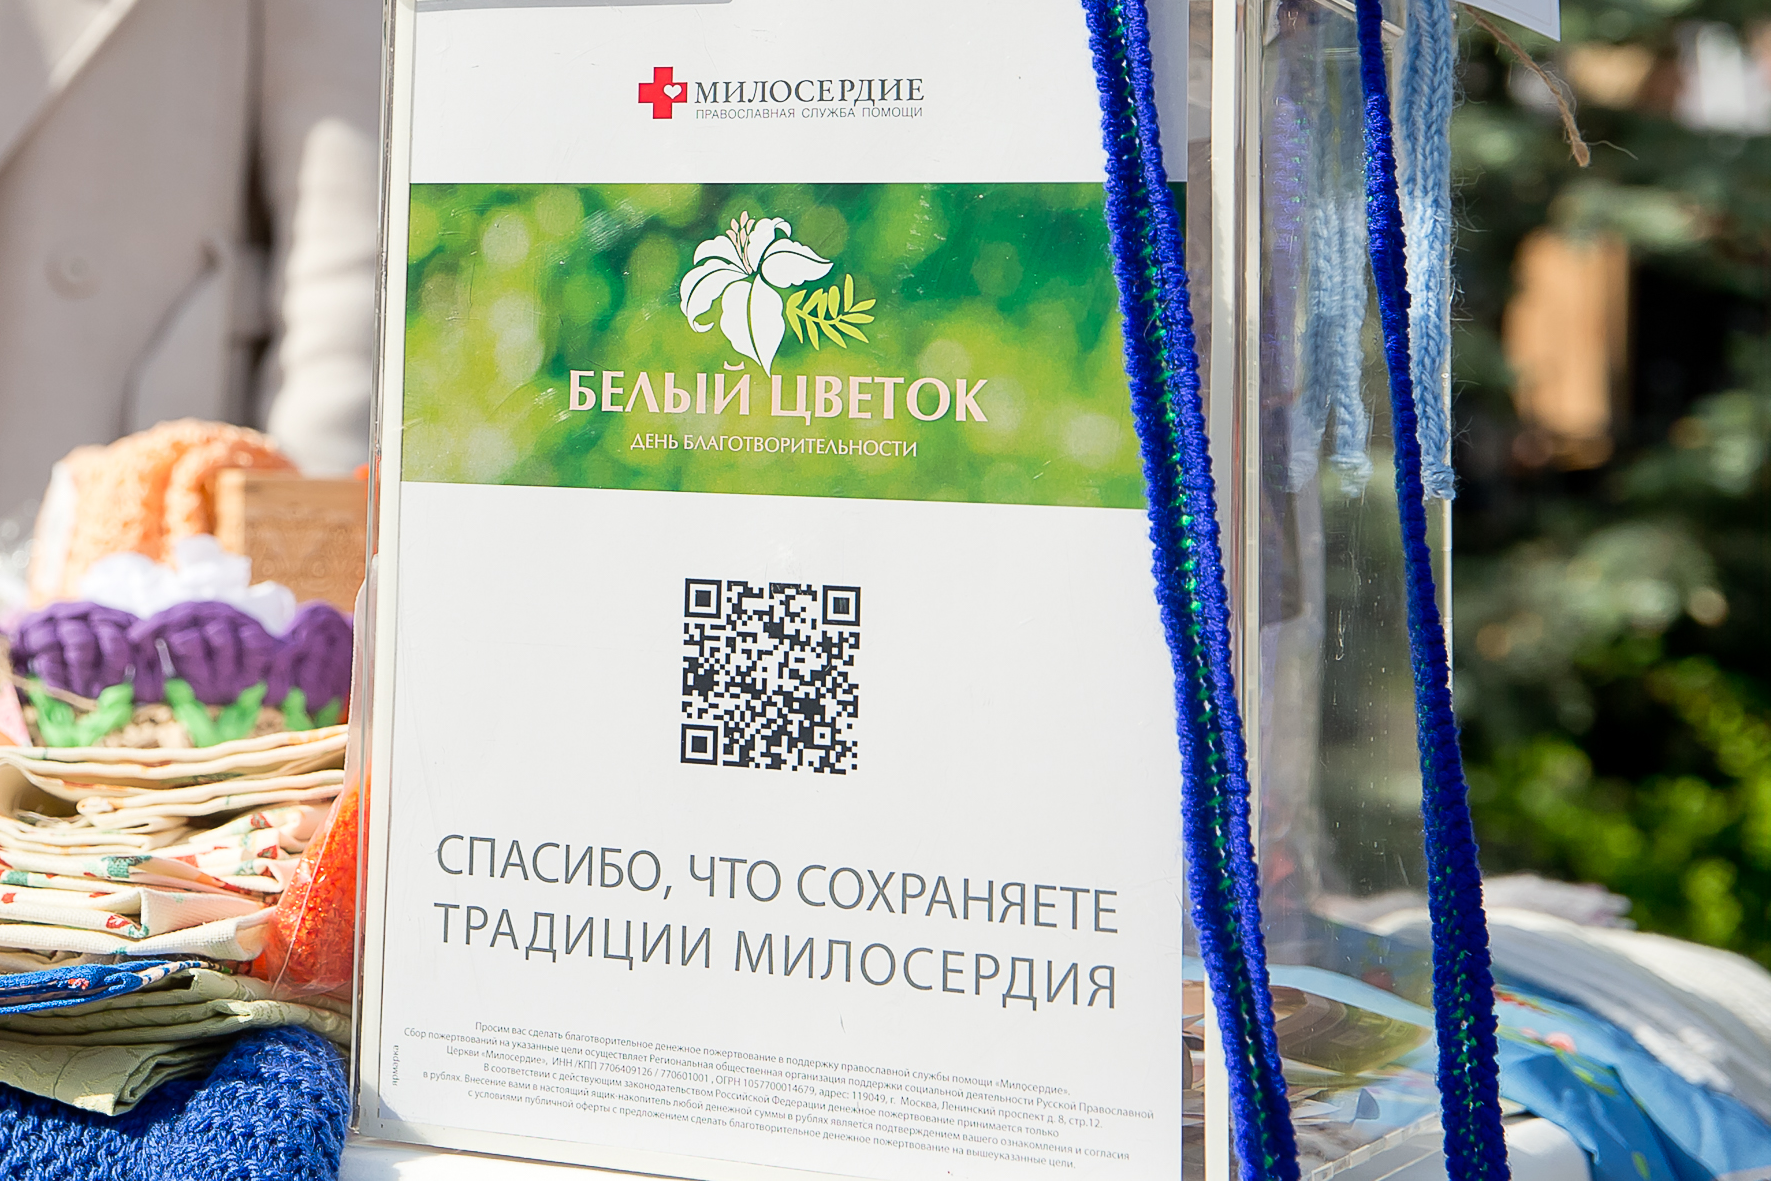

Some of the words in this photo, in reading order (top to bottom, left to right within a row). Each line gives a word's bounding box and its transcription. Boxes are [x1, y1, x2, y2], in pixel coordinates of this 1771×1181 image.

[694, 78, 925, 107] МИЛОСЕРДИЕ
[696, 108, 795, 120] ПРАВОСЛАВНАЯ
[801, 107, 856, 119] СЛУЖБА
[862, 106, 923, 119] ПОМОЩИ
[568, 360, 751, 416] БЕЛЫЙ
[770, 374, 989, 426] ЦВЕТОК
[630, 433, 679, 452] ДЕНЬ
[683, 434, 918, 458] БЛАГОТВОРИТЕЛЬНОСТИ
[436, 834, 673, 901] СПАСИБО,
[689, 854, 782, 903] ЧТО
[797, 864, 1119, 934] СОХРАНЯЕТЕ
[433, 902, 711, 971] ТРАДИЦИИ
[734, 930, 1116, 1011] МИЛОСЕРДИЯ
[403, 1026, 427, 1040] Сбор
[427, 1031, 498, 1046] пожертвований
[511, 1040, 560, 1053] указанные
[560, 1045, 583, 1055] цели
[584, 1048, 648, 1062] осуществляет
[648, 1052, 714, 1070] Региональная
[714, 1060, 783, 1078] общественная
[784, 1070, 846, 1085] организация
[847, 1077, 903, 1091] поддержки
[904, 1083, 964, 1098] социальной
[964, 1090, 1034, 1106] деятельности
[1035, 1096, 1077, 1111] Русской
[1078, 1101, 1154, 1119] Православной
[446, 1044, 480, 1057] Церкви
[551, 1056, 573, 1067] ИНН
[714, 1074, 741, 1087] ОГРН
[940, 1100, 996, 1116] Ленинский
[997, 1108, 1044, 1122] проспект
[474, 1020, 510, 1034] Просим
[511, 1026, 527, 1036] вас
[527, 1028, 564, 1040] сделать
[564, 1030, 654, 1050] благотворительное
[654, 1042, 702, 1055] денежное
[702, 1047, 777, 1063] пожертвование
[785, 1056, 840, 1072] поддержку
[840, 1062, 910, 1078] православной
[911, 1070, 950, 1082] службы
[951, 1074, 993, 1088] помощи
[464, 1073, 507, 1088] Внесение
[507, 1079, 531, 1090] вами
[539, 1084, 589, 1097] настоящий
[590, 1089, 672, 1106] ящик-накопитель
[672, 1098, 704, 1110] любой
[704, 1102, 752, 1116] денежной
[753, 1108, 786, 1119] суммы
[794, 1112, 829, 1125] рублях
[830, 1117, 873, 1130] является
[874, 1122, 961, 1140] подтверждением
[961, 1133, 999, 1145] вашего
[999, 1137, 1073, 1154] ознакомления
[1083, 1148, 1130, 1160] согласия
[474, 1089, 523, 1102] условиями
[524, 1094, 574, 1108] публичной
[575, 1100, 611, 1113] оферты
[618, 1106, 689, 1122] предложением
[689, 1114, 728, 1127] сделать
[728, 1117, 821, 1138] благотворительное
[821, 1130, 871, 1144] денежное
[872, 1136, 950, 1153] пожертвование
[965, 1148, 1047, 1165] вышеуказанные
[490, 1064, 551, 1079] соответствии
[557, 1071, 622, 1087] действующим
[623, 1079, 714, 1097] законодательством
[714, 1087, 770, 1104] Российской
[770, 1094, 826, 1111] Федерации
[826, 1101, 876, 1116] денежное
[877, 1109, 955, 1126] пожертвование
[956, 1118, 1023, 1133] принимается
[1024, 1126, 1060, 1138] только
